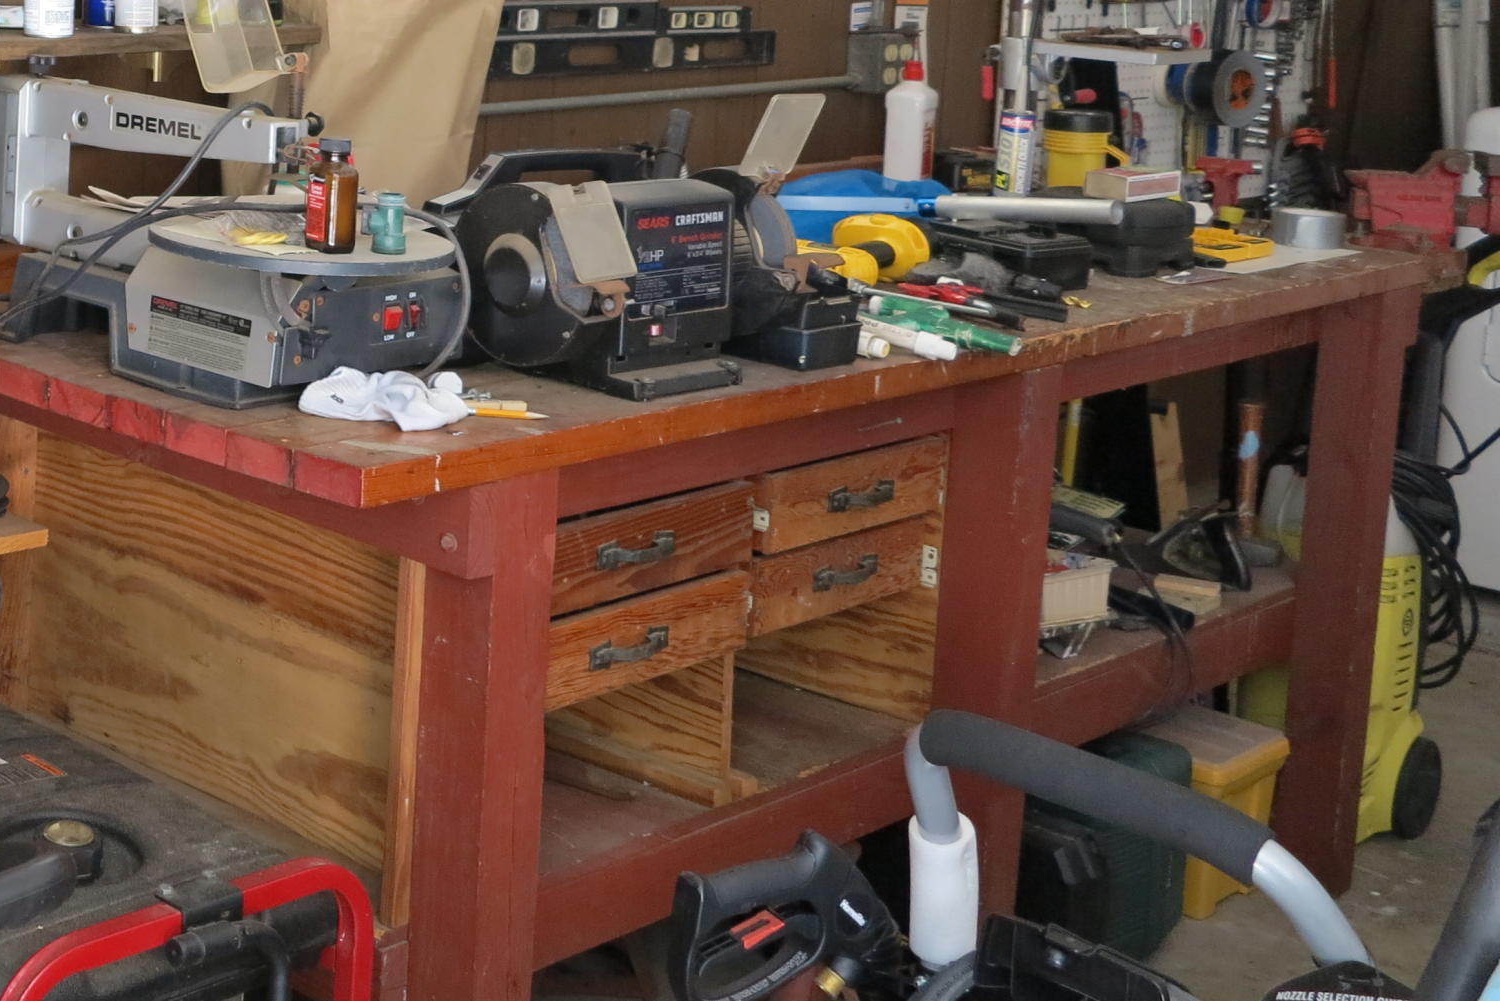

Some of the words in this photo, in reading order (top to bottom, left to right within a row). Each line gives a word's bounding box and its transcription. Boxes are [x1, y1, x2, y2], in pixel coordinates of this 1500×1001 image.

[116, 111, 202, 141] DREMEL
[637, 216, 672, 230] SEARS
[675, 210, 724, 226] CRAFTSMAN
[1275, 991, 1315, 1001] NOZZLE
